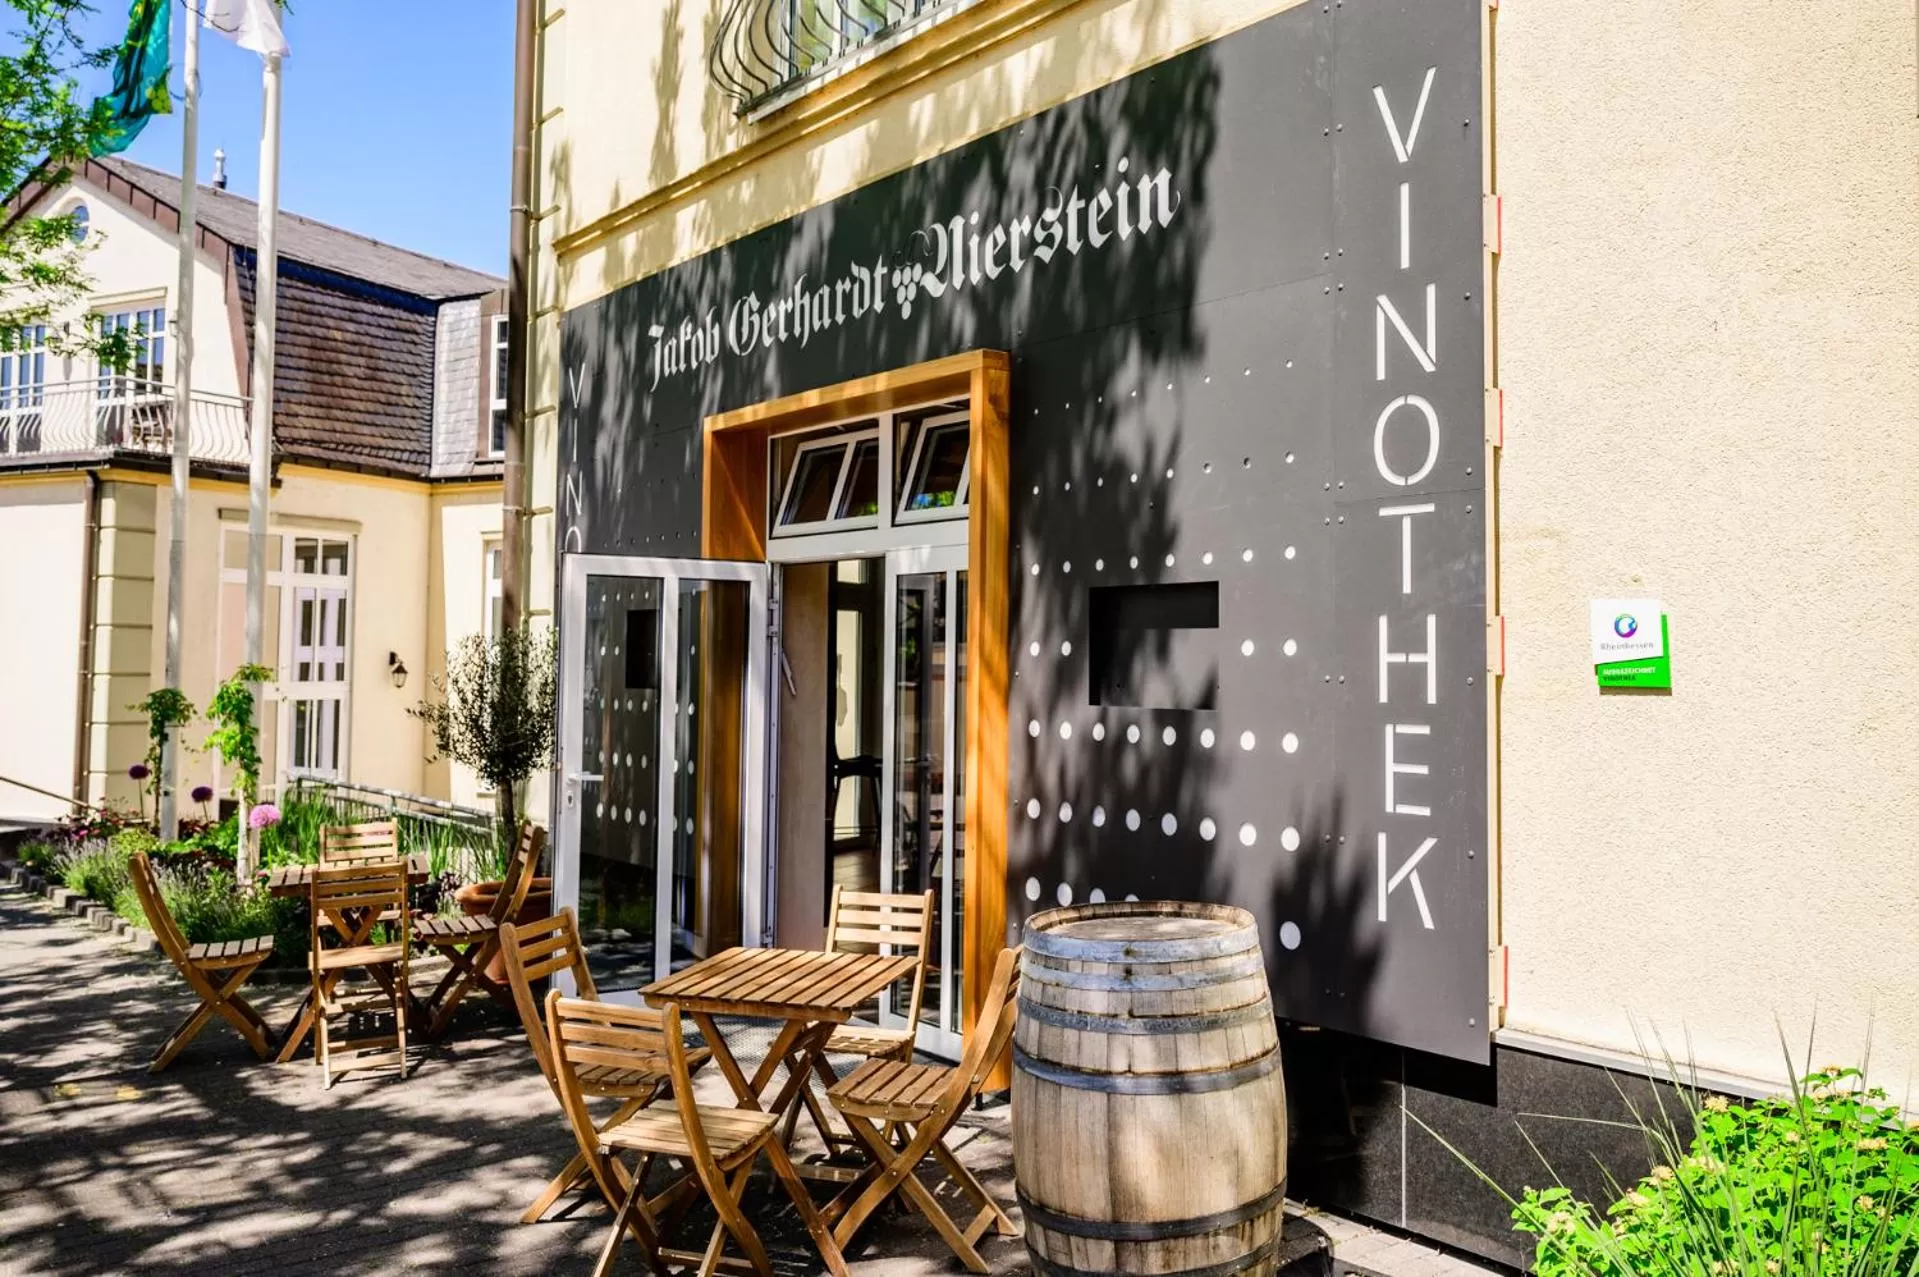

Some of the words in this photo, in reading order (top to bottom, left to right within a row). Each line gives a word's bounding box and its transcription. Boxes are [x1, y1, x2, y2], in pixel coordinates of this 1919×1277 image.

[648, 305, 720, 392] Jakob
[729, 254, 888, 356] Gerhardt
[912, 156, 1181, 298] Nierstein
[1372, 66, 1440, 931] VINOTHEK
